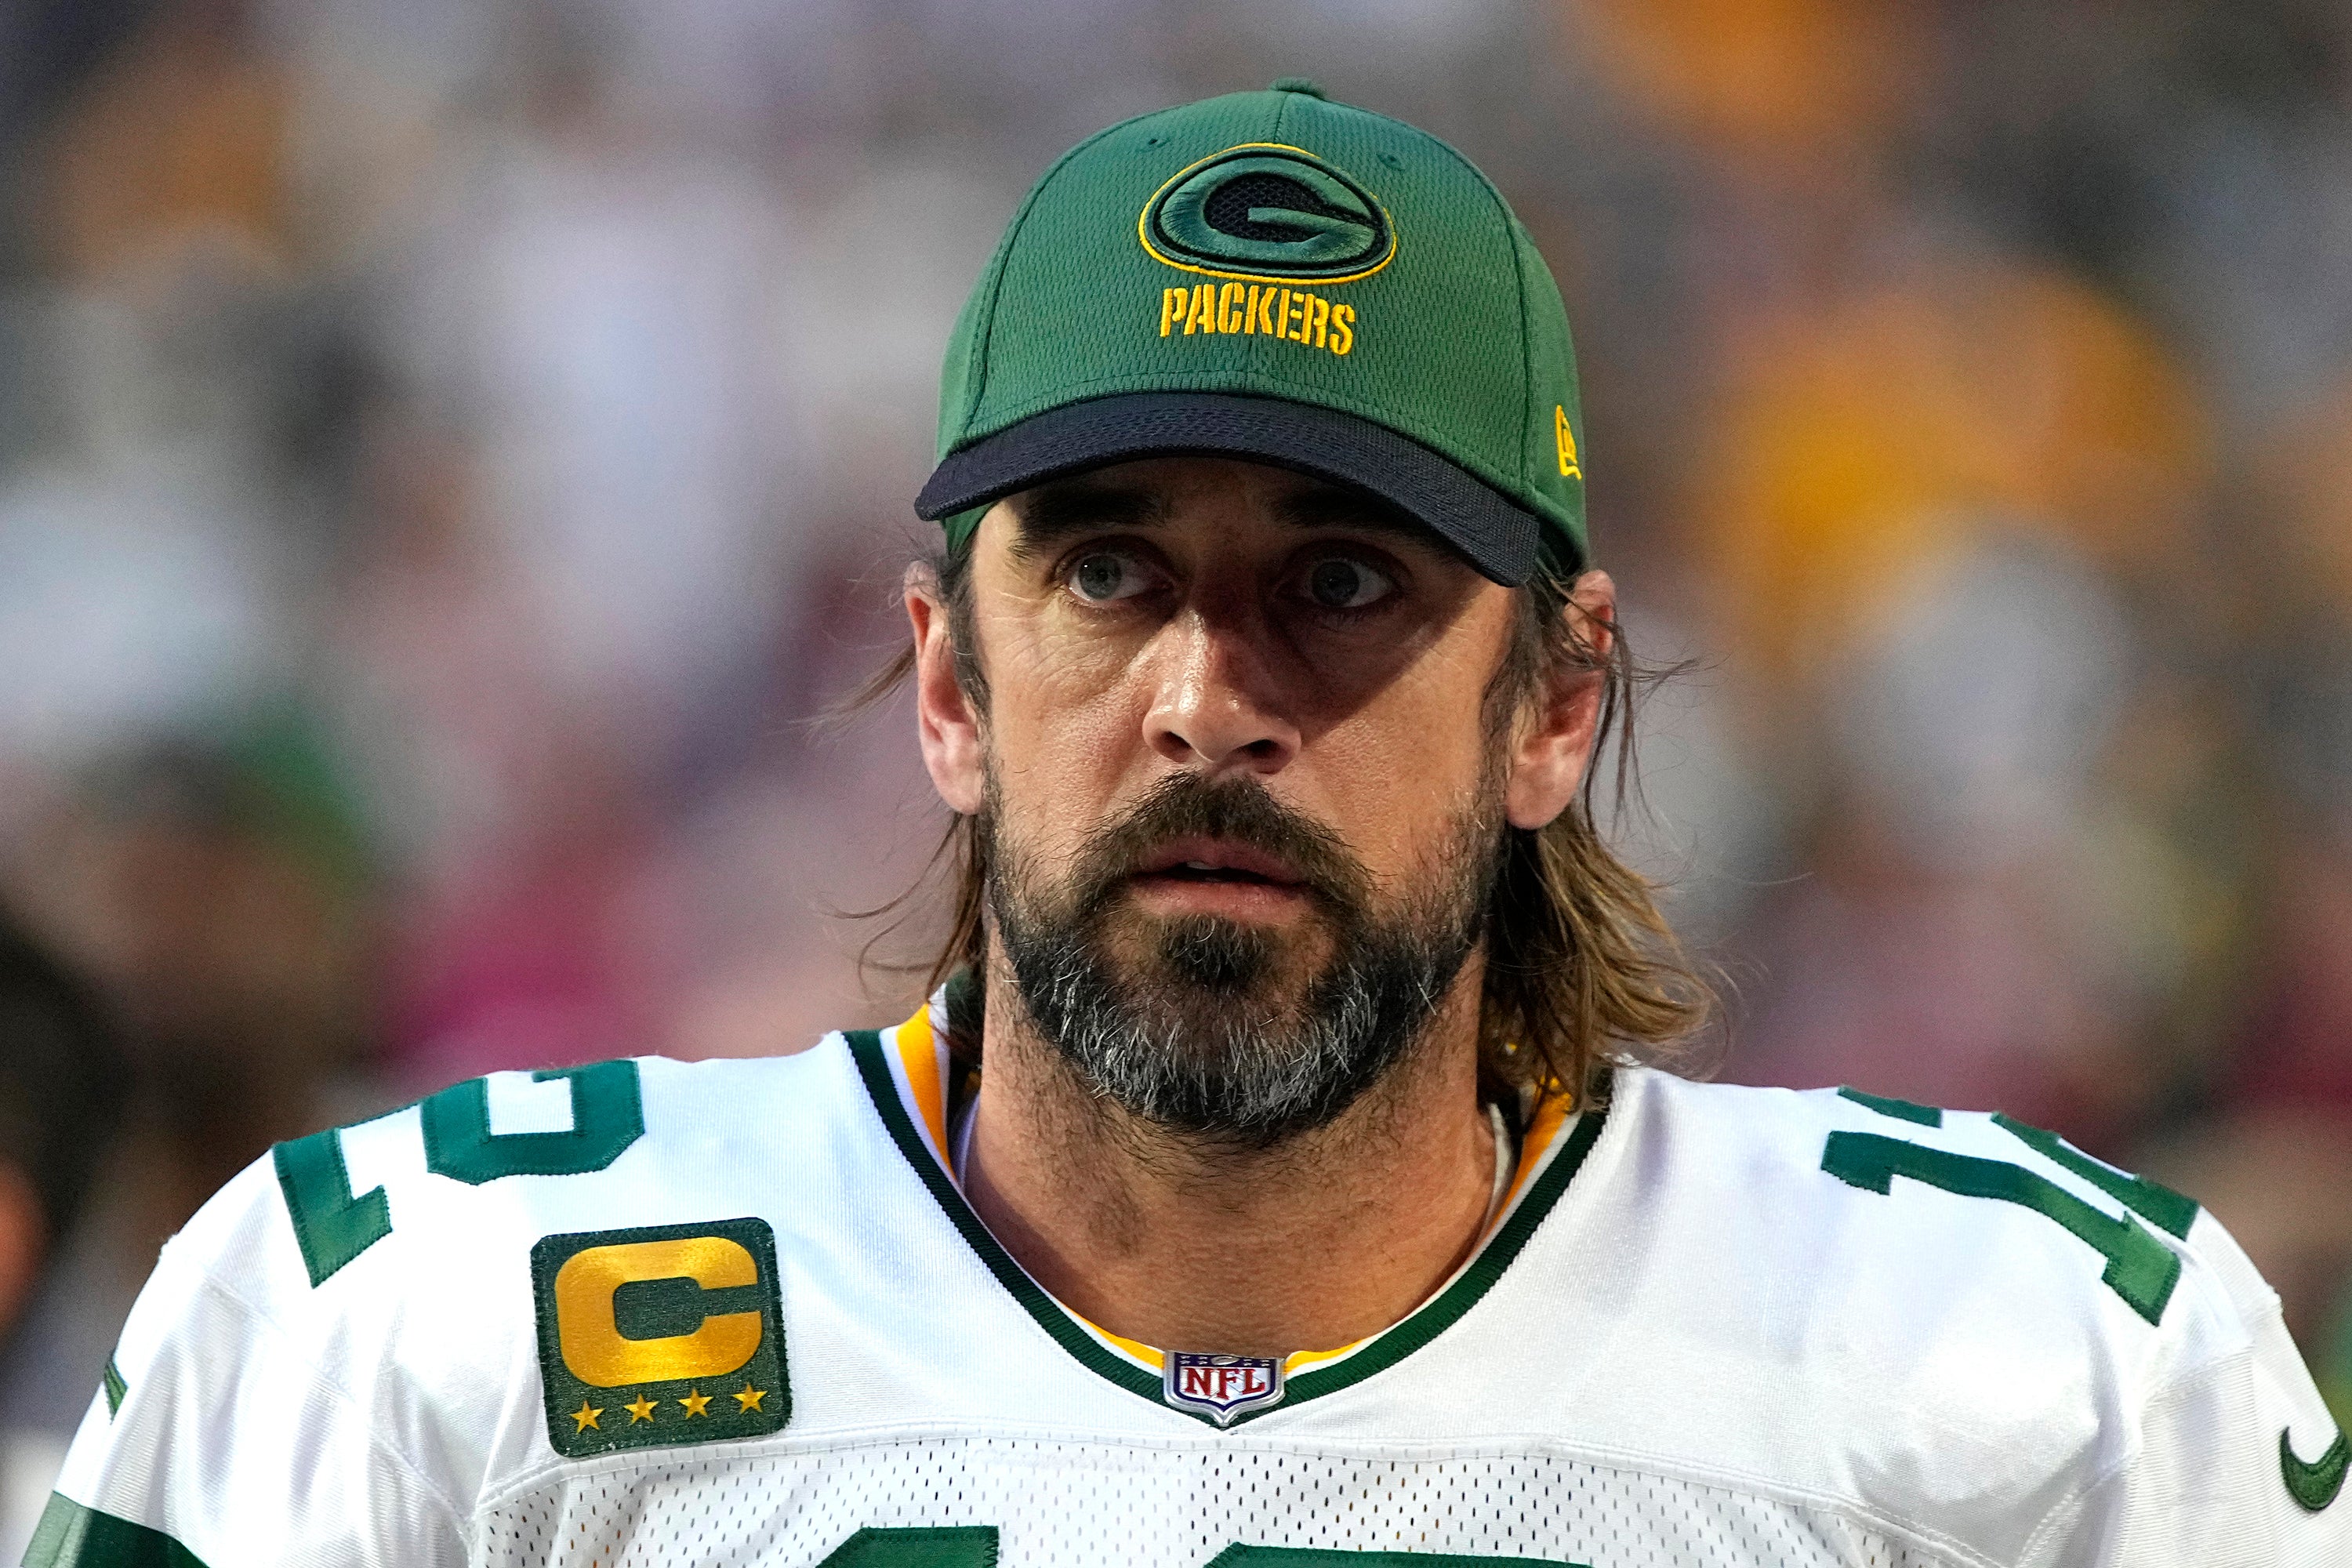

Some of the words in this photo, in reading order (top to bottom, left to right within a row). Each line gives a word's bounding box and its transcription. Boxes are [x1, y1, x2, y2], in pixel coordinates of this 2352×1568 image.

[1160, 156, 1377, 267] G
[1160, 282, 1356, 356] PACKERS
[554, 1236, 763, 1388] C
[1184, 1367, 1266, 1400] NFL
